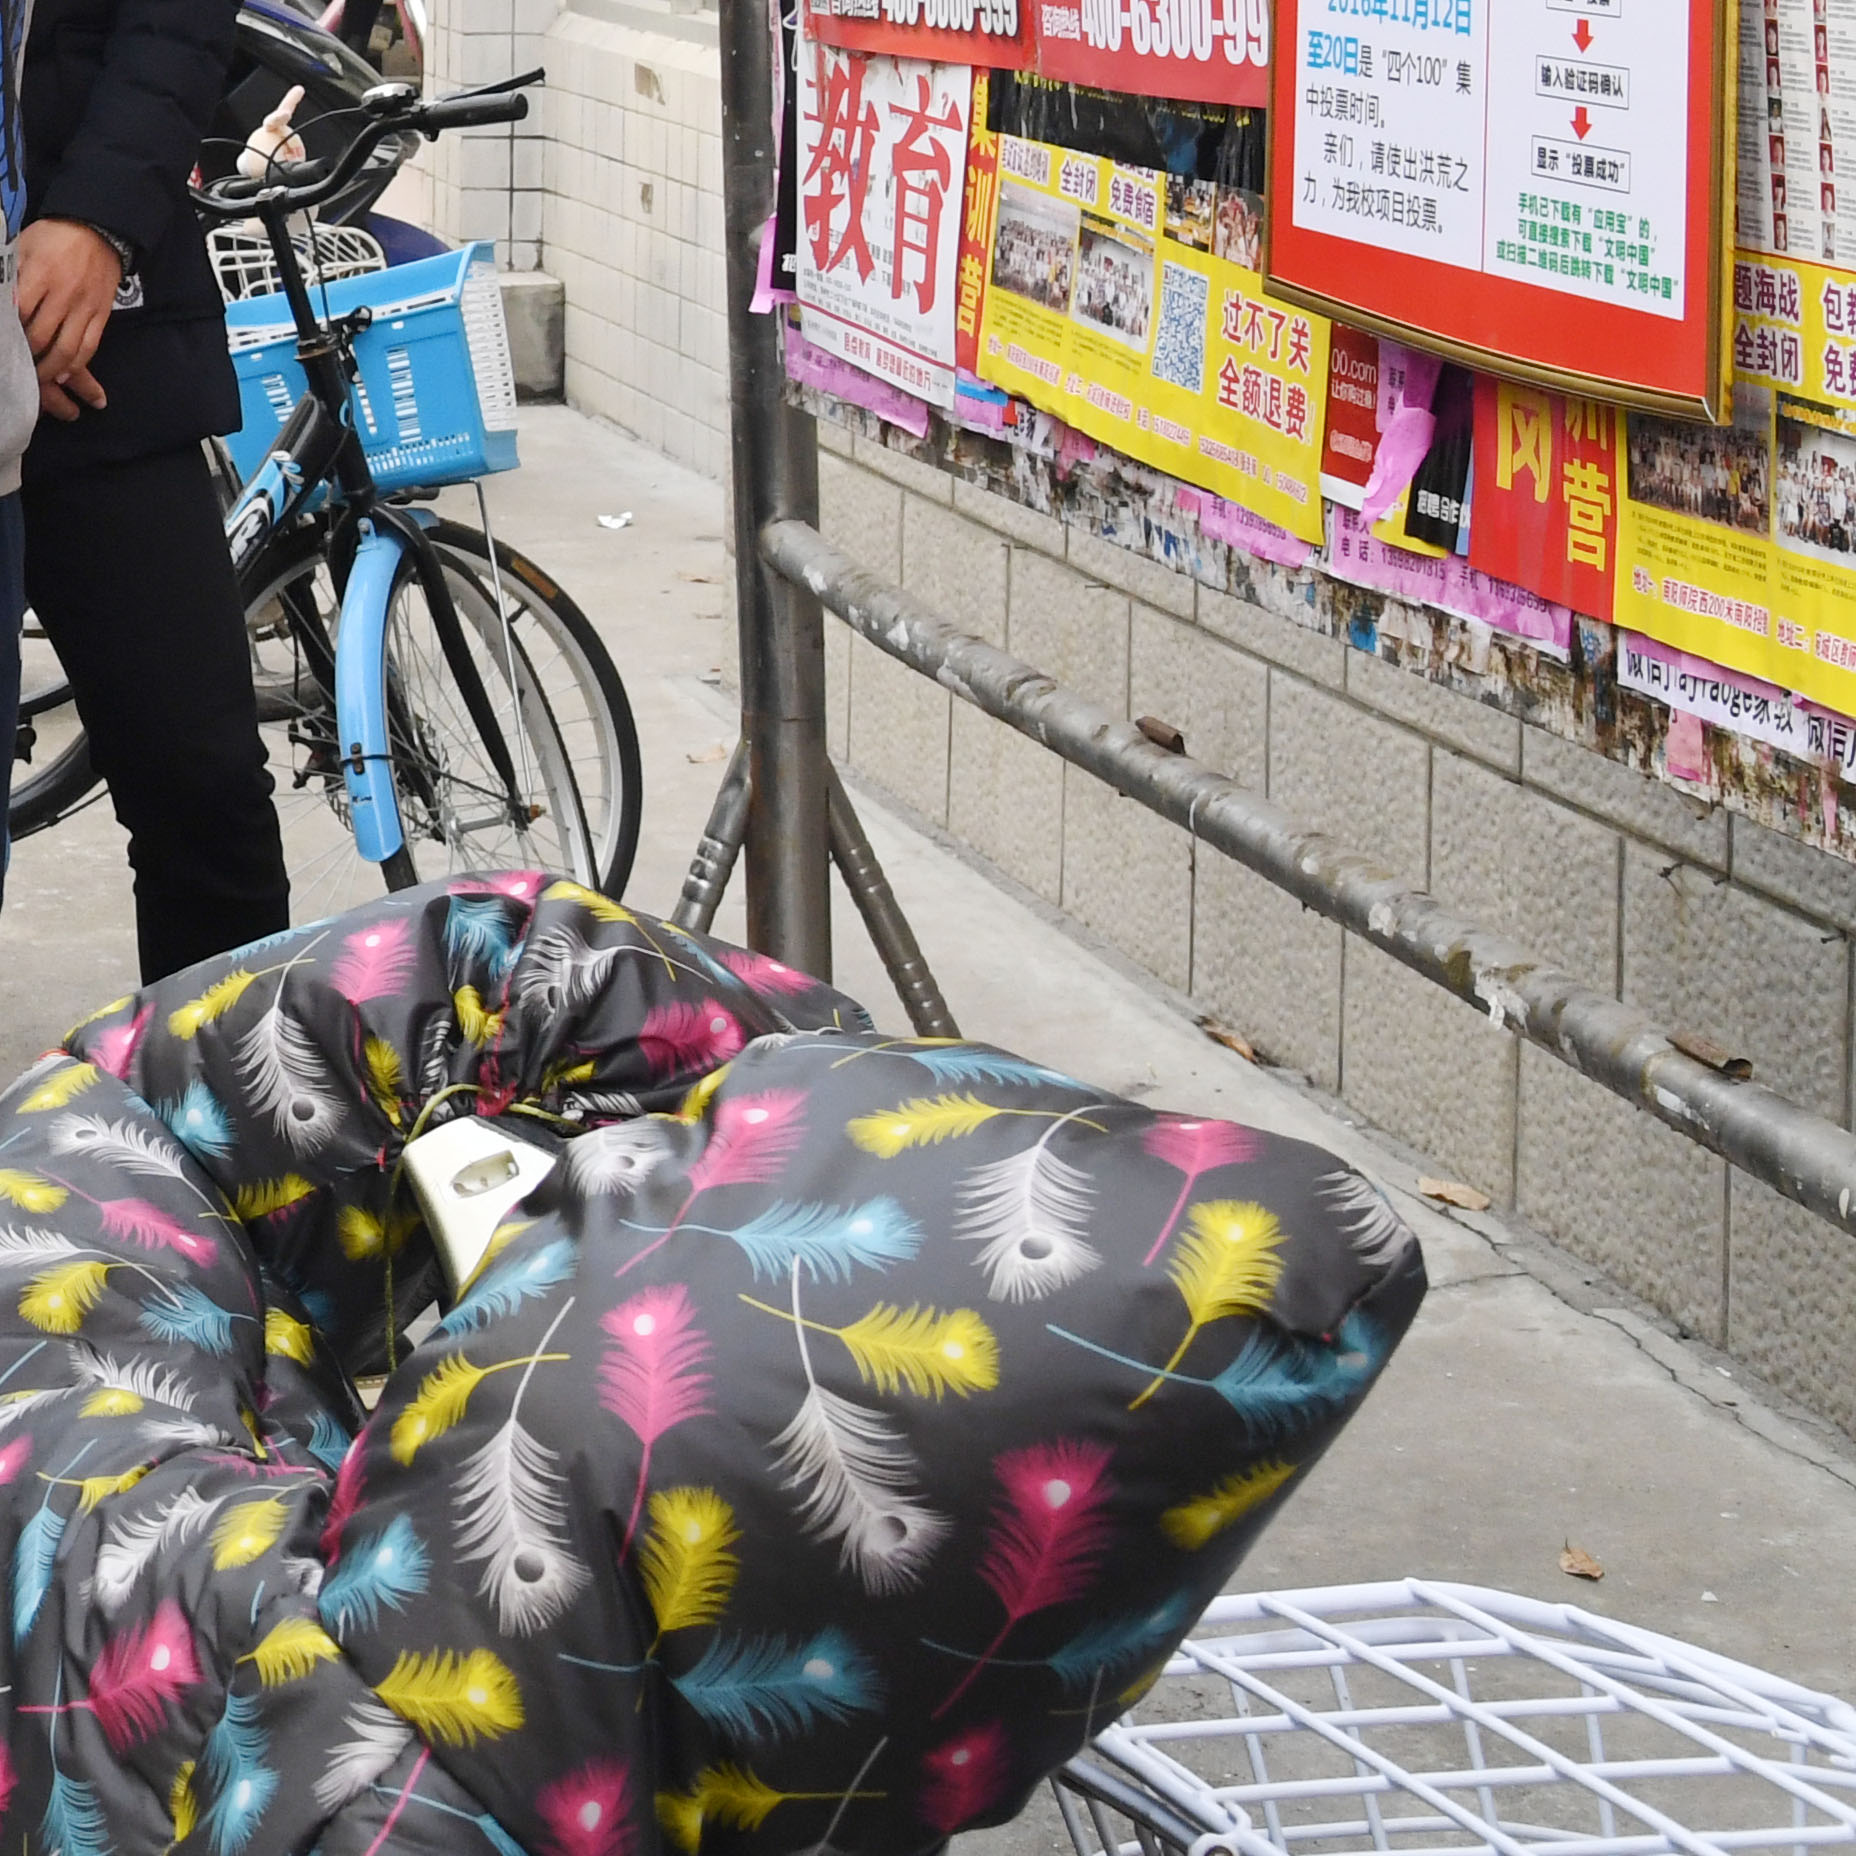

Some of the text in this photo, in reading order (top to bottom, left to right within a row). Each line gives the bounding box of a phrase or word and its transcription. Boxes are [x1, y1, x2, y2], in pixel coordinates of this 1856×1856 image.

[1540, 64, 1624, 98] 输入验证码确认
[803, 51, 963, 315] 教育
[1323, 131, 1470, 193] 亲们，请使出洪荒之
[1222, 290, 1309, 373] 过不了关
[1733, 323, 1800, 382] 全封闭
